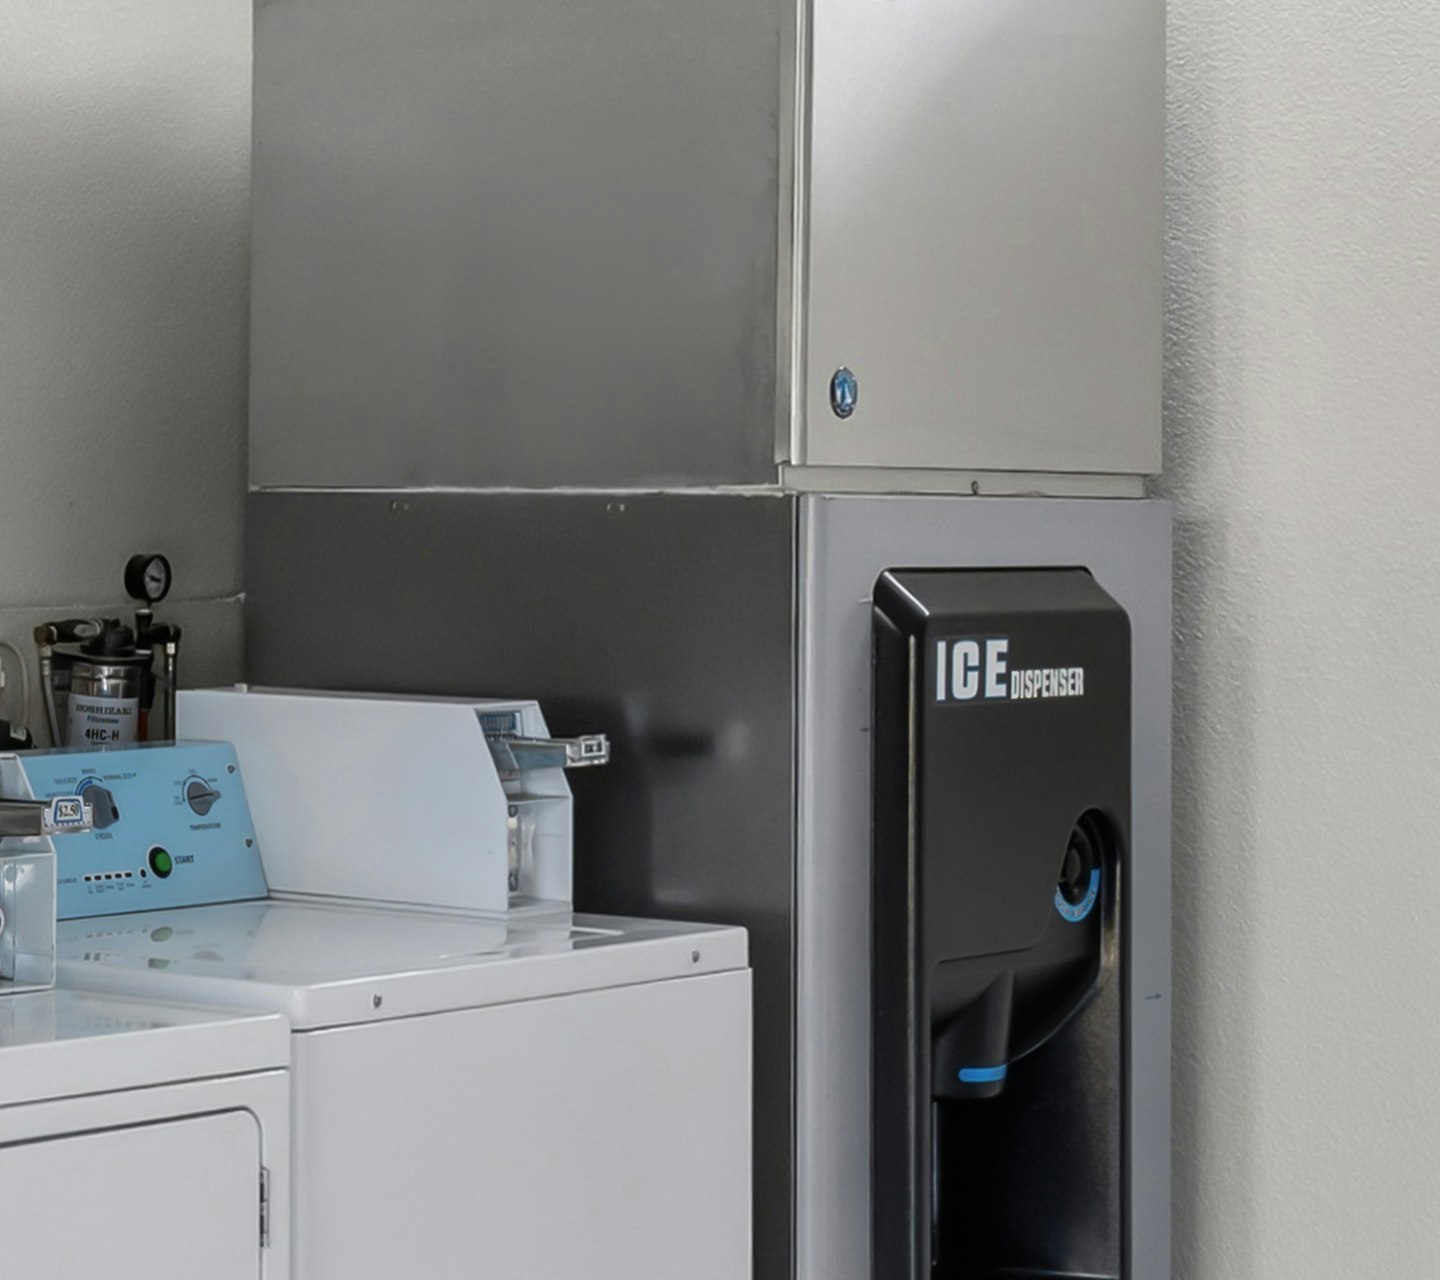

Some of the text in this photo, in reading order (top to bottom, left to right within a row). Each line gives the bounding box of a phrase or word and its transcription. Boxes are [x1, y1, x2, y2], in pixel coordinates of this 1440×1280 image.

[936, 639, 1085, 702] ICE DISPENSER
[75, 704, 132, 715] HOSHIZAKI
[85, 728, 120, 741] 4HC-H
[175, 855, 195, 865] START
